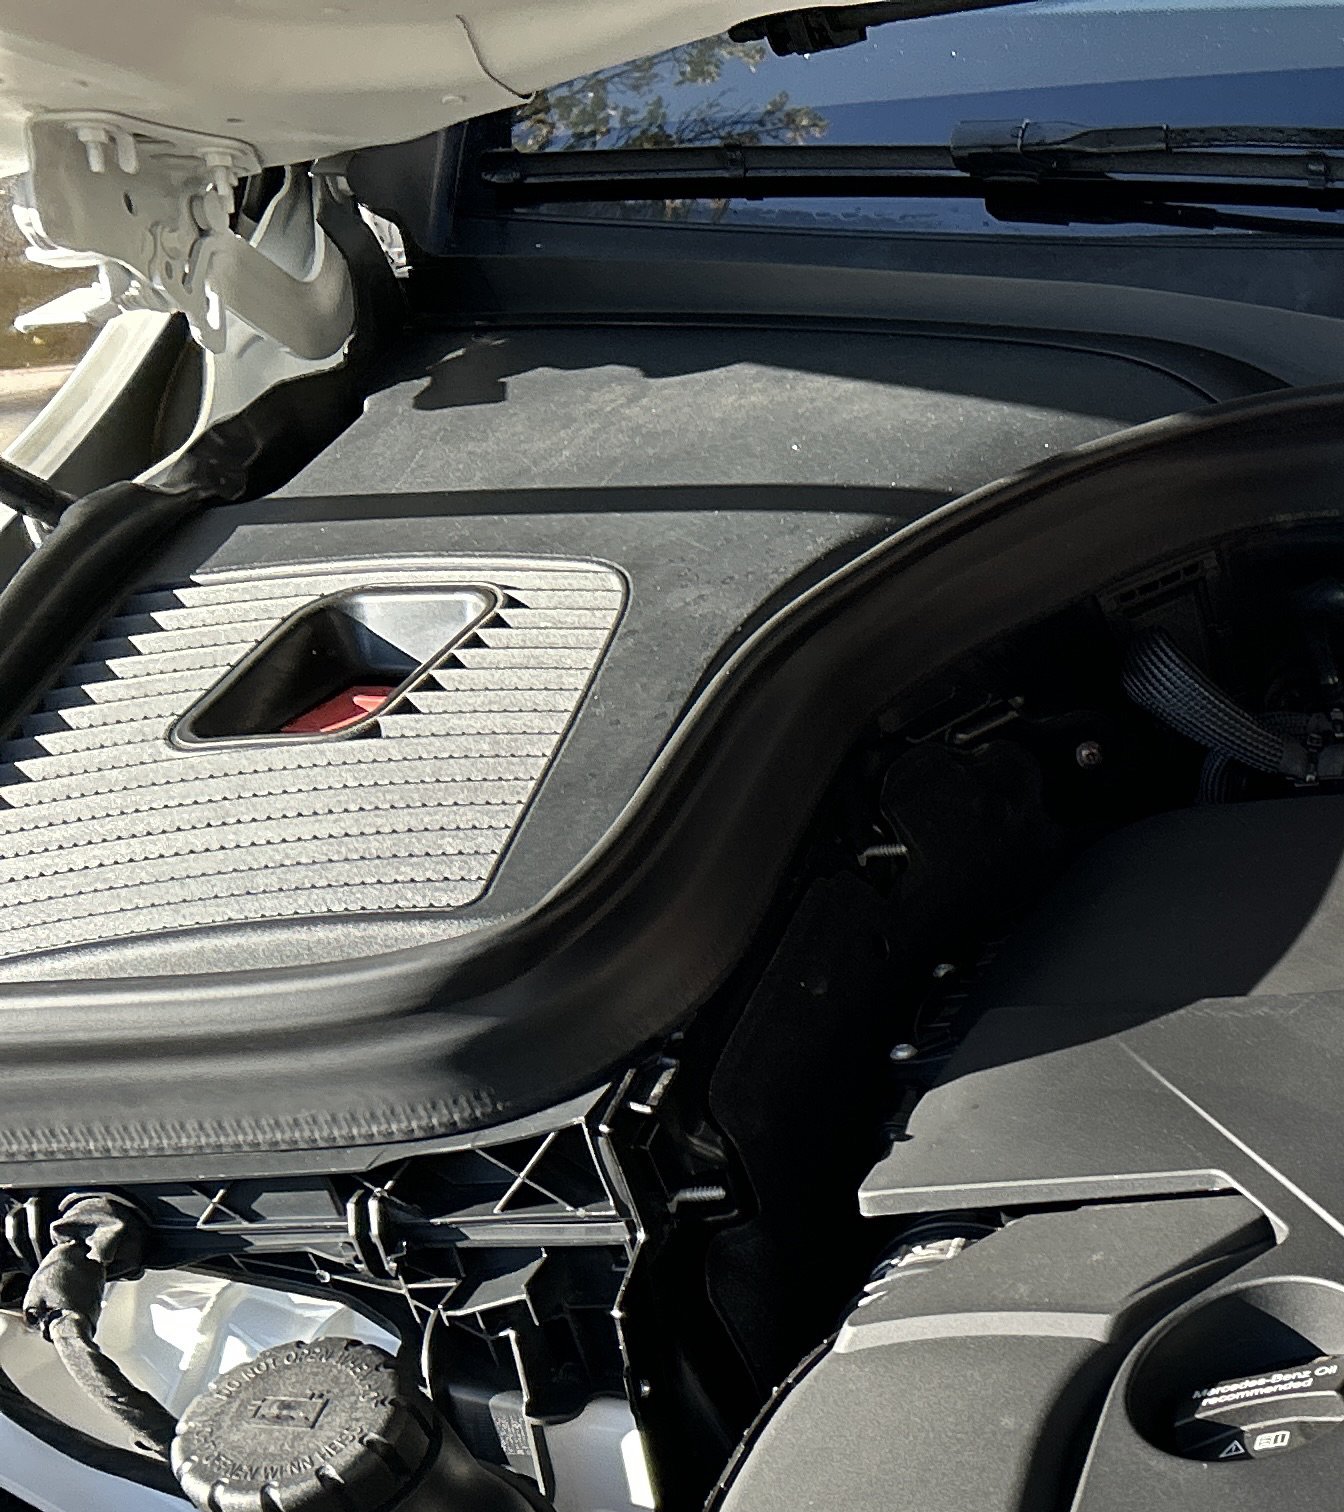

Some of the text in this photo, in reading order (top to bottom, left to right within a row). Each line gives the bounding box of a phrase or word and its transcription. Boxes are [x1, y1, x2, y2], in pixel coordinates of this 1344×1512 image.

[241, 1358, 277, 1381] NOT
[1192, 1364, 1338, 1399] Mercedes-Benz Oil
[1201, 1378, 1314, 1406] recommended
